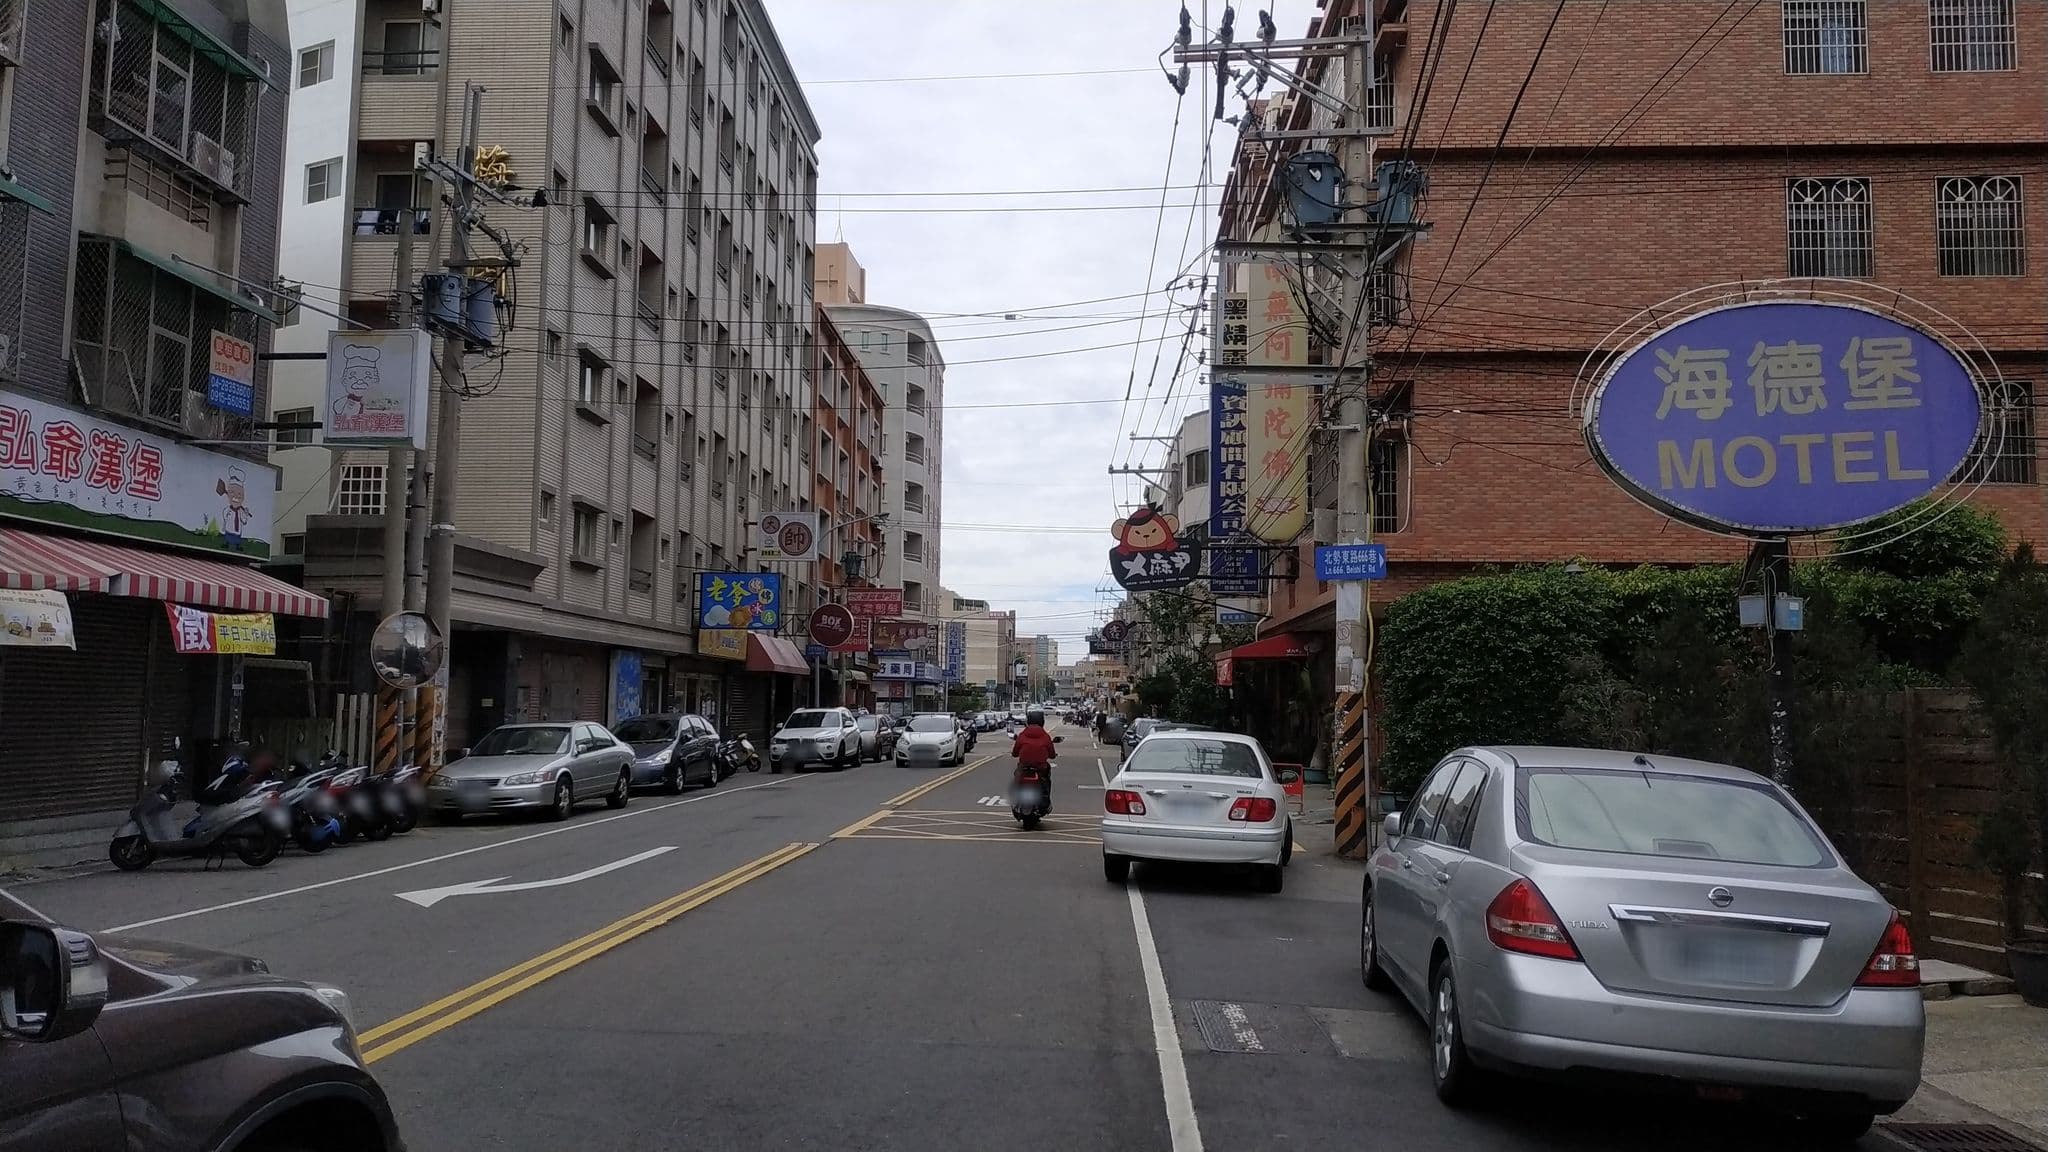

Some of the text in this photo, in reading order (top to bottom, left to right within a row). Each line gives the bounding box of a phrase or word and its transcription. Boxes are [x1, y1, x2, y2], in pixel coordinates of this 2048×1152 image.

[1654, 337, 1922, 420] 海德堡
[334, 412, 405, 433] 弘爺漢堡
[0, 404, 163, 501] 弘爺漢堡
[1658, 430, 1929, 490] MOTEL
[785, 527, 805, 551] 帥
[1325, 549, 1376, 565] 北勢東路666巷
[707, 576, 752, 608] 老爹
[821, 614, 842, 626] BOX
[1568, 920, 1609, 929] TIIDA
